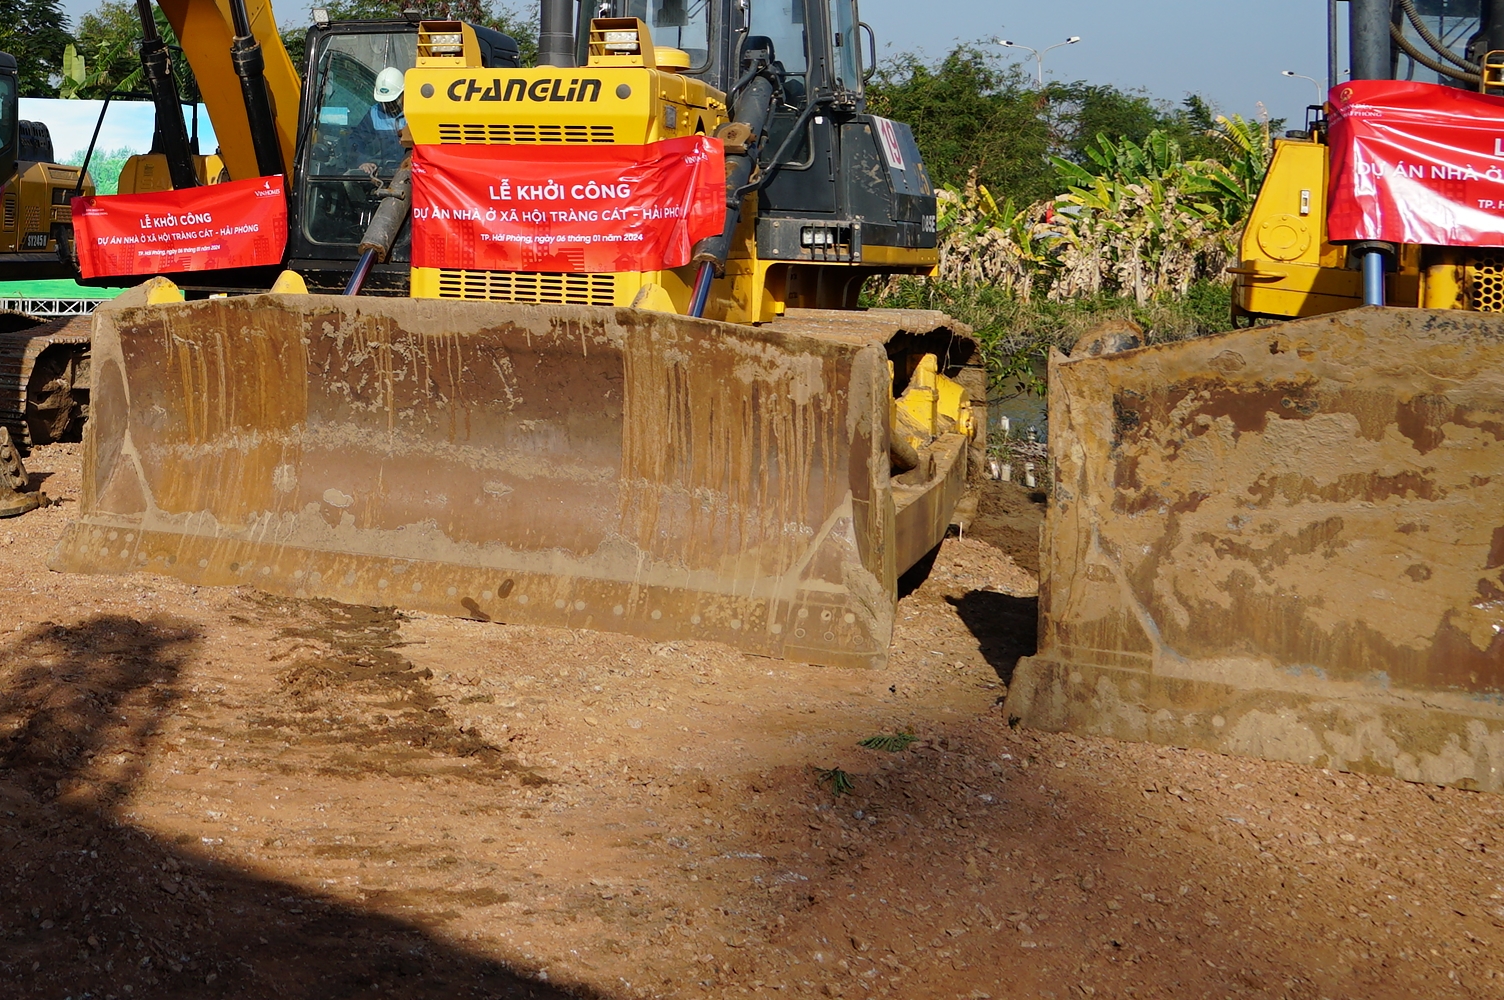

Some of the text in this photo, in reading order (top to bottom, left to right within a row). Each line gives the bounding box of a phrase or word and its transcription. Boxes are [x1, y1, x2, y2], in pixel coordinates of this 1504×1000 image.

[881, 119, 902, 165] 19
[1494, 138, 1504, 156] L
[1392, 161, 1424, 179] ÁN
[1431, 164, 1478, 181] NHÀ
[1485, 164, 1502, 181] Ở
[489, 178, 631, 200] LỄ KHỞI CÔNG
[414, 207, 428, 221] DỰ
[431, 206, 450, 218] ÁN
[453, 208, 481, 220] NHÀ
[486, 207, 496, 221] Ở
[500, 209, 519, 222] XÃ
[522, 209, 546, 224] HỘI
[550, 208, 598, 222] TRÀNG
[602, 208, 627, 220] CÁT
[642, 204, 662, 219] HẢI
[664, 204, 680, 218] PHÒ
[1478, 199, 1496, 209] TP.
[140, 212, 212, 228] LỄ KHỞI CÔNG
[98, 237, 108, 245] DỰ
[110, 235, 122, 244] ÁN
[123, 234, 140, 244] NHÀ
[141, 234, 146, 243] Ở
[147, 234, 157, 242] XÃ
[158, 232, 170, 242] HỘI
[172, 230, 196, 240] TRÀNG
[198, 229, 213, 238] CÁT
[220, 226, 233, 236] HẢI
[234, 224, 259, 234] PHÒNG
[506, 234, 532, 243] Phòng,
[534, 235, 555, 244] ngày
[567, 234, 590, 244] tháng
